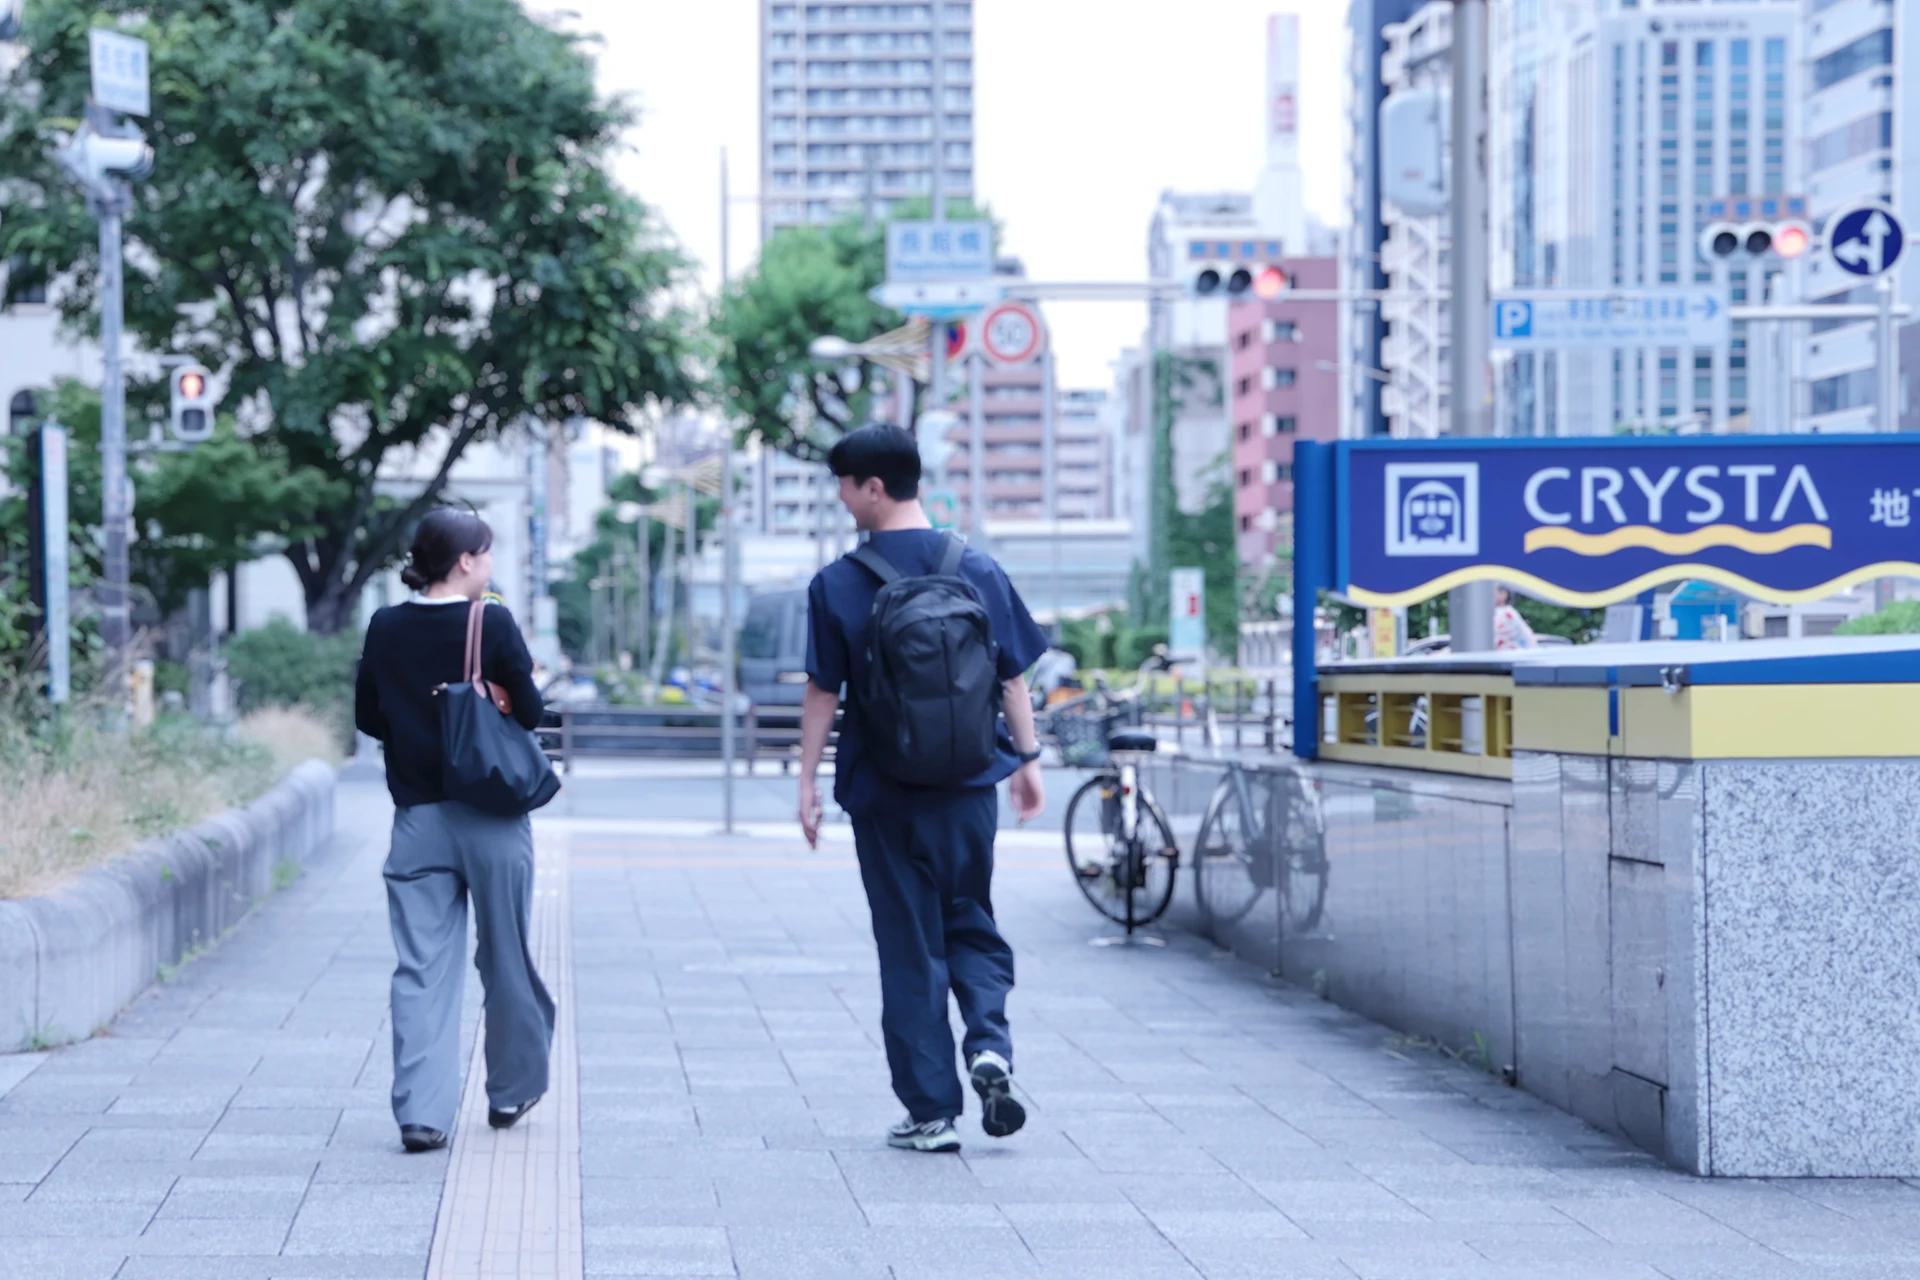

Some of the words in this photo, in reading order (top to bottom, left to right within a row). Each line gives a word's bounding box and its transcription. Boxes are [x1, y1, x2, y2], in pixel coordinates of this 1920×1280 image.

[995, 319, 1024, 346] 50
[1500, 301, 1527, 337] P
[1524, 465, 1828, 524] CRYSTA
[1869, 487, 1920, 527] 地
